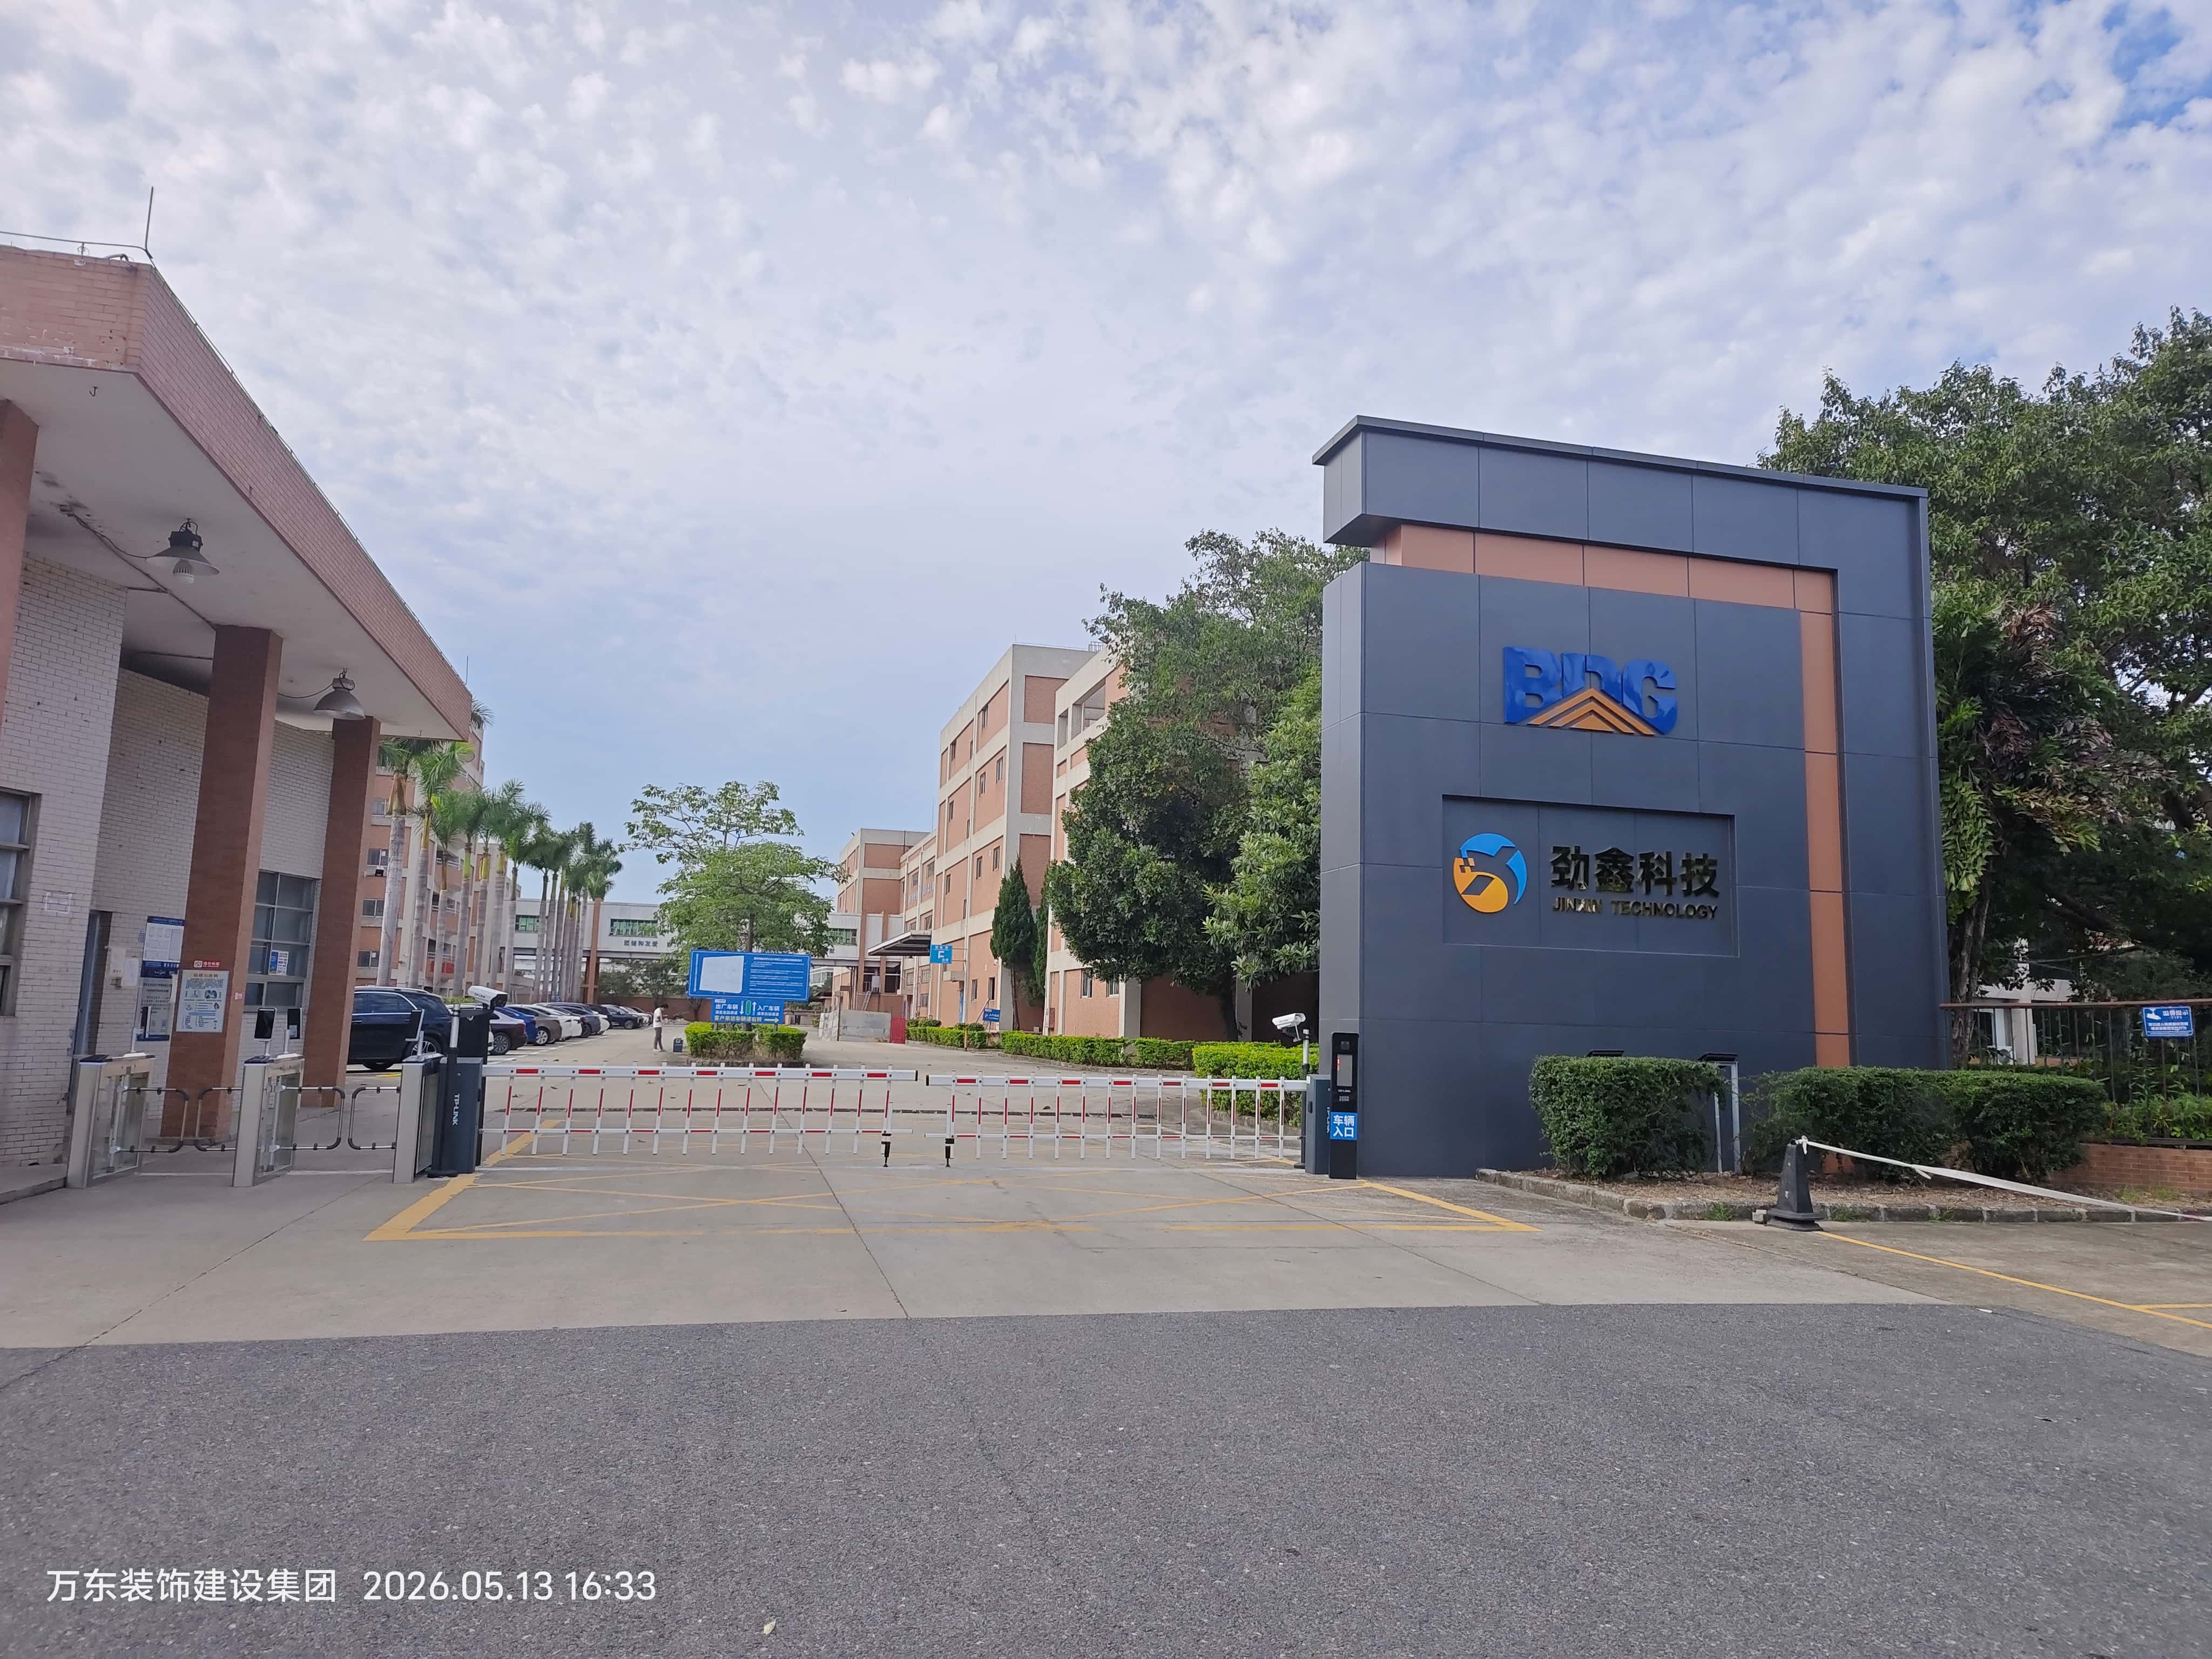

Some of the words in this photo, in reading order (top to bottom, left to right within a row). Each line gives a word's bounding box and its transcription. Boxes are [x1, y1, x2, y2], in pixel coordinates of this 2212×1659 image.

[1550, 845, 1719, 898] 劲鑫科技
[1553, 896, 1603, 914] JINXIN
[1611, 900, 1718, 919] TECHNOLOGY
[1333, 1115, 1355, 1127] 车辆
[1333, 1127, 1354, 1138] 入口
